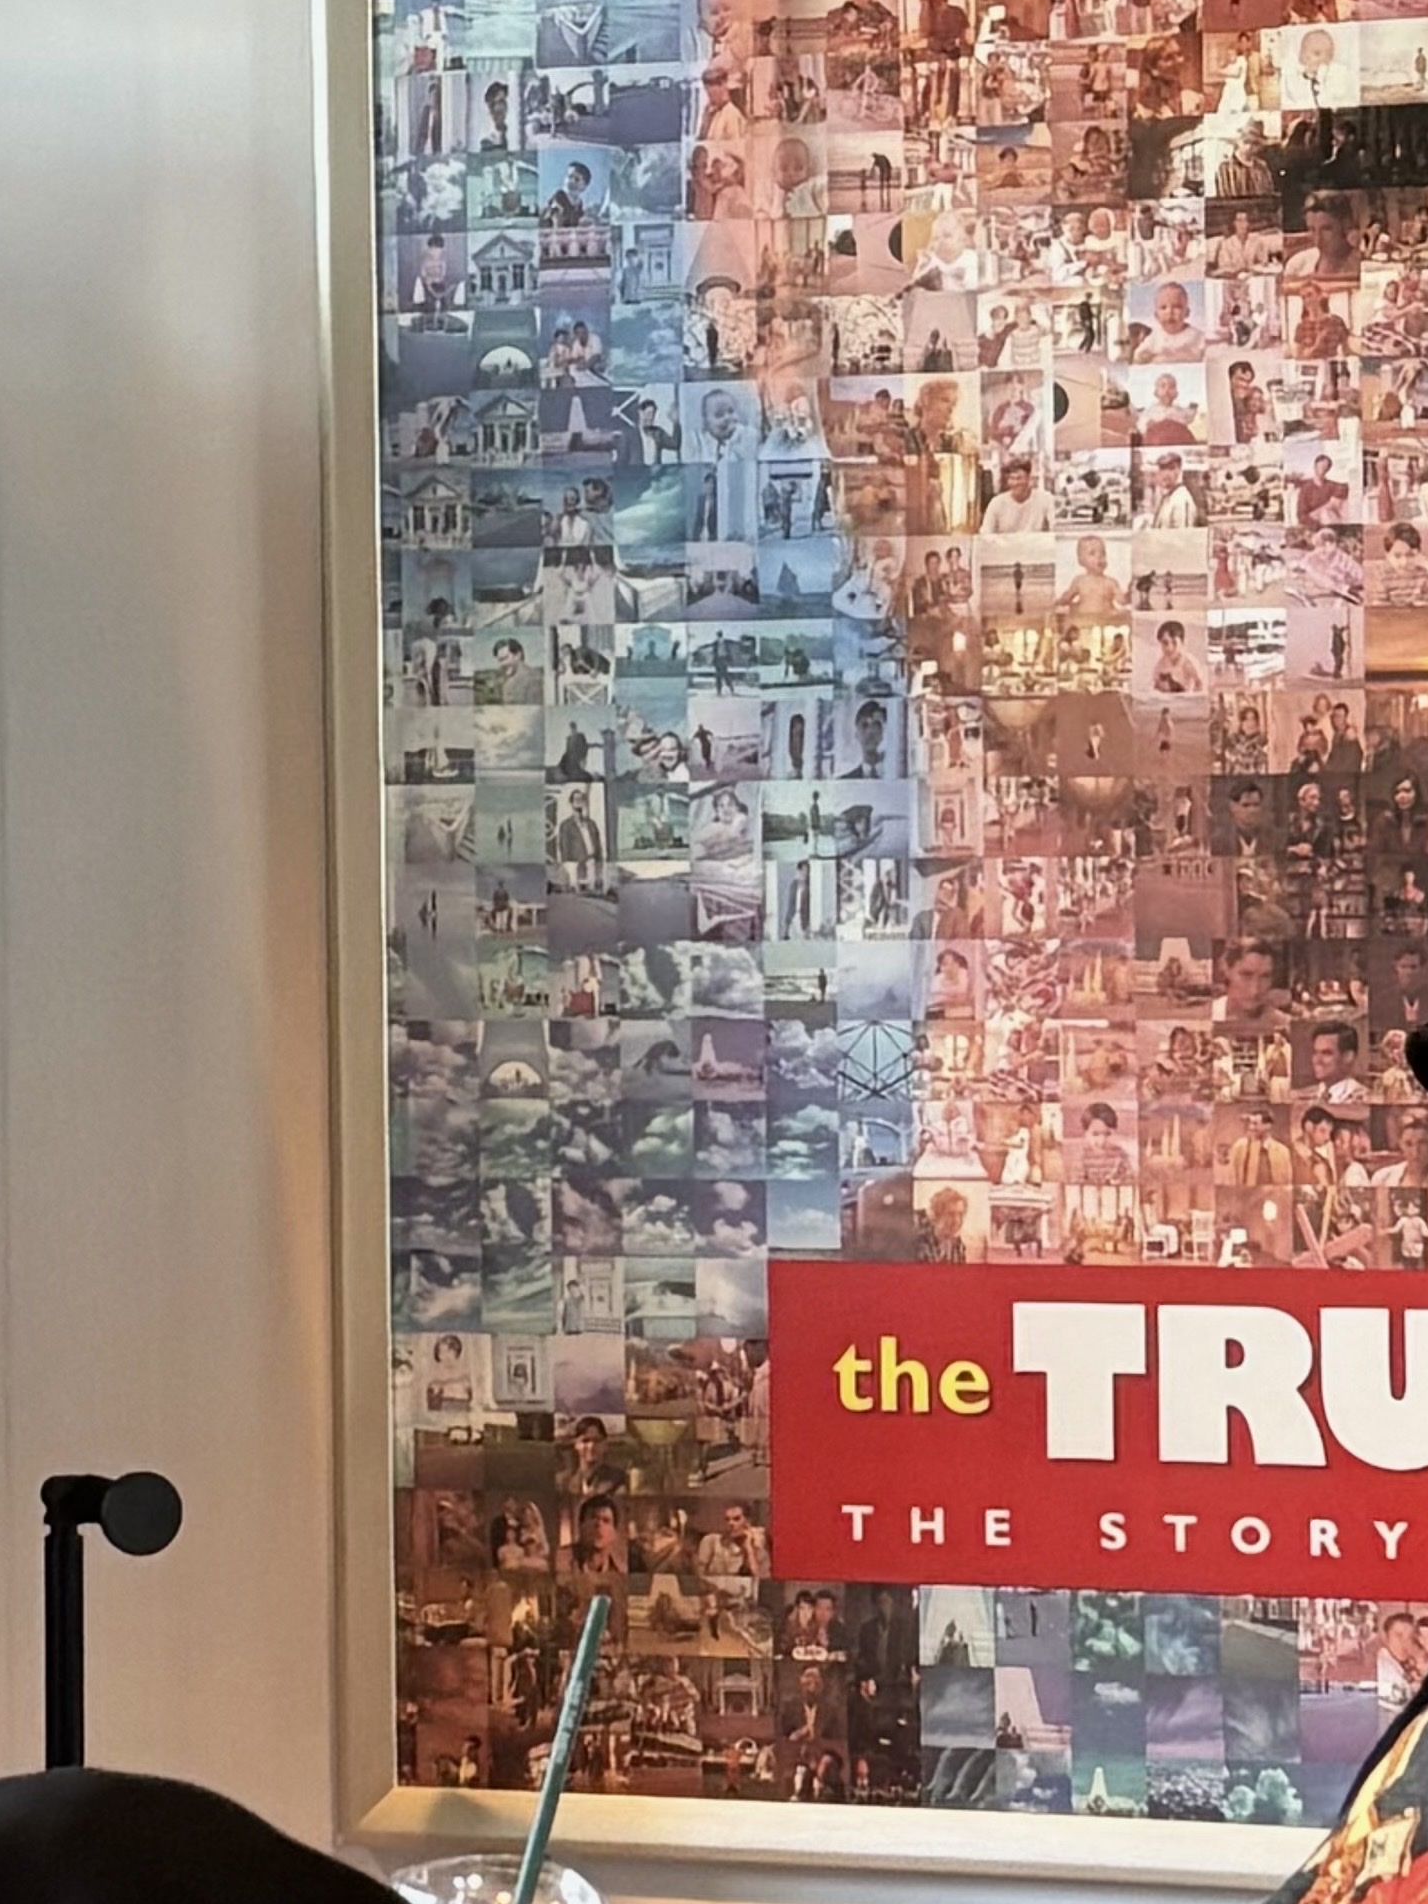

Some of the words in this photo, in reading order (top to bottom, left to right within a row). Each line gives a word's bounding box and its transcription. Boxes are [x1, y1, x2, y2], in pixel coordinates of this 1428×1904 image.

[832, 1334, 992, 1415] the
[840, 1504, 1012, 1548] THE
[1098, 1511, 1409, 1561] STORY
